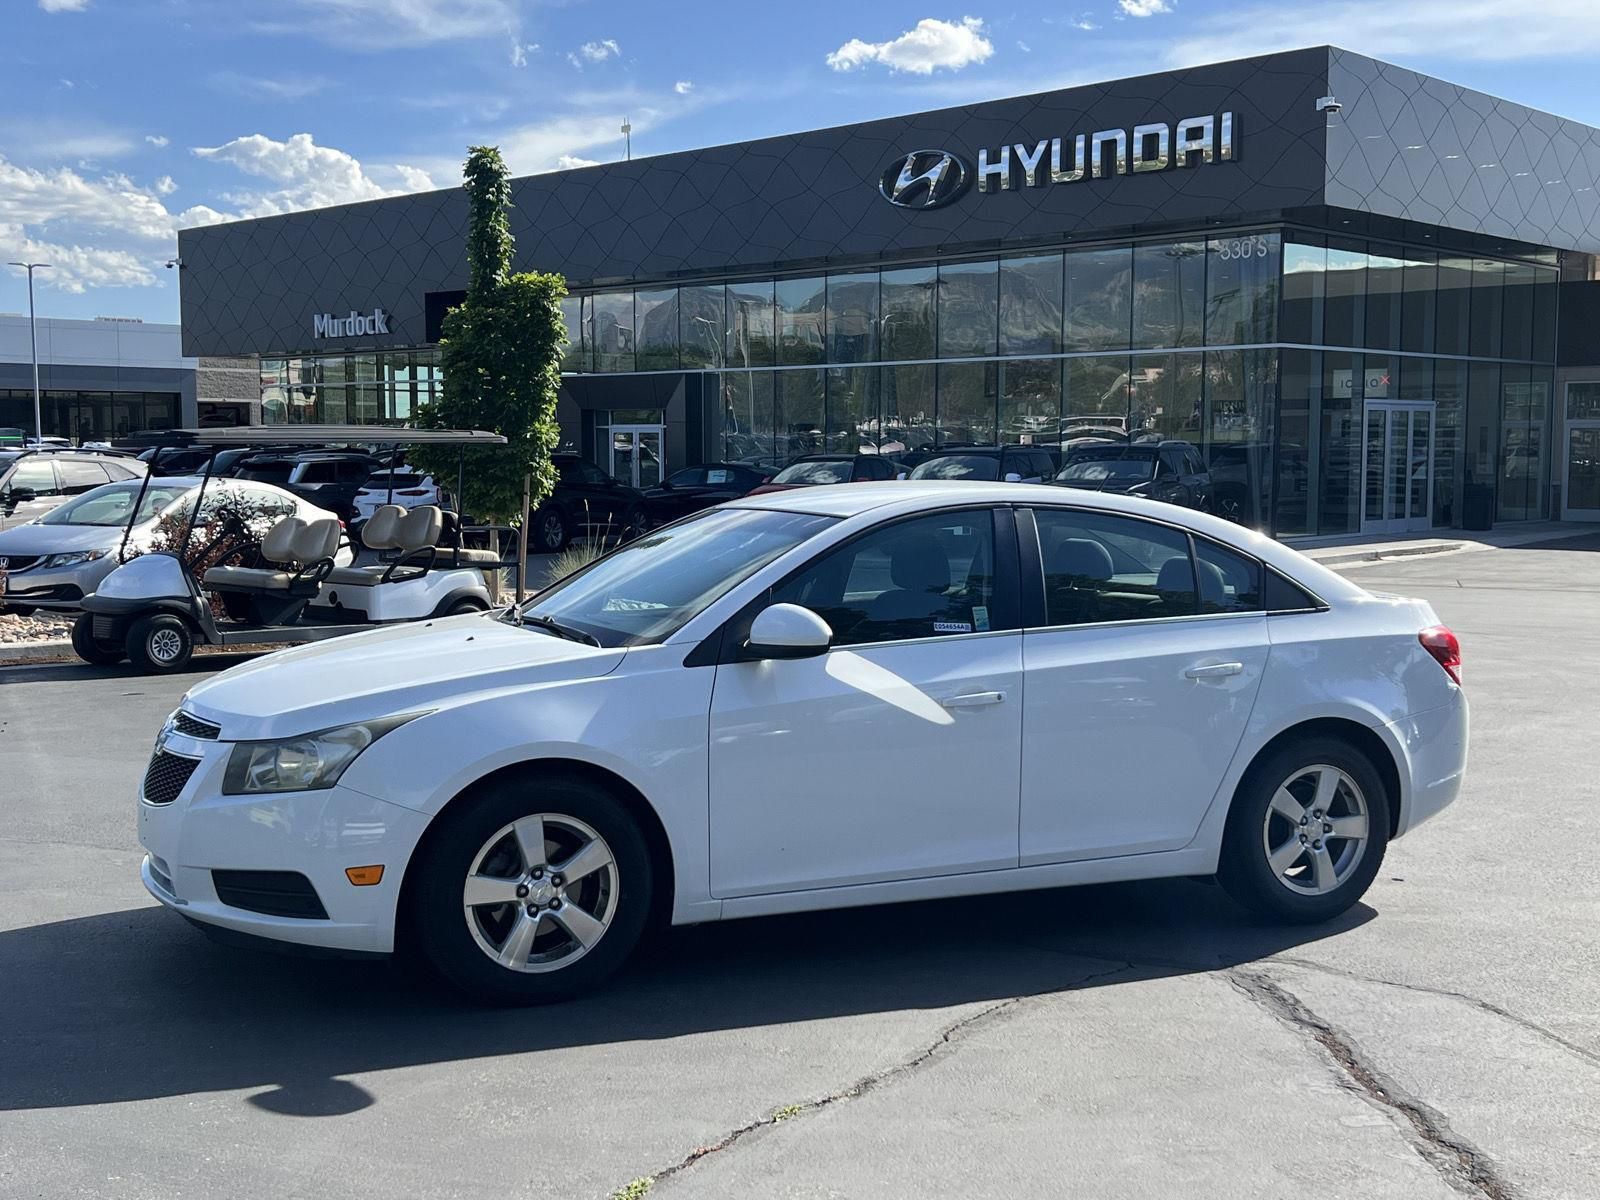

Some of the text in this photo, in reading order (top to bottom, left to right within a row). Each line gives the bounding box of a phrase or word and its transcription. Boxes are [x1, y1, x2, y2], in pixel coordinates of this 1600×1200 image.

[977, 111, 1234, 193] HYUNDAI
[1256, 239, 1267, 257] S
[313, 308, 389, 339] Murdock
